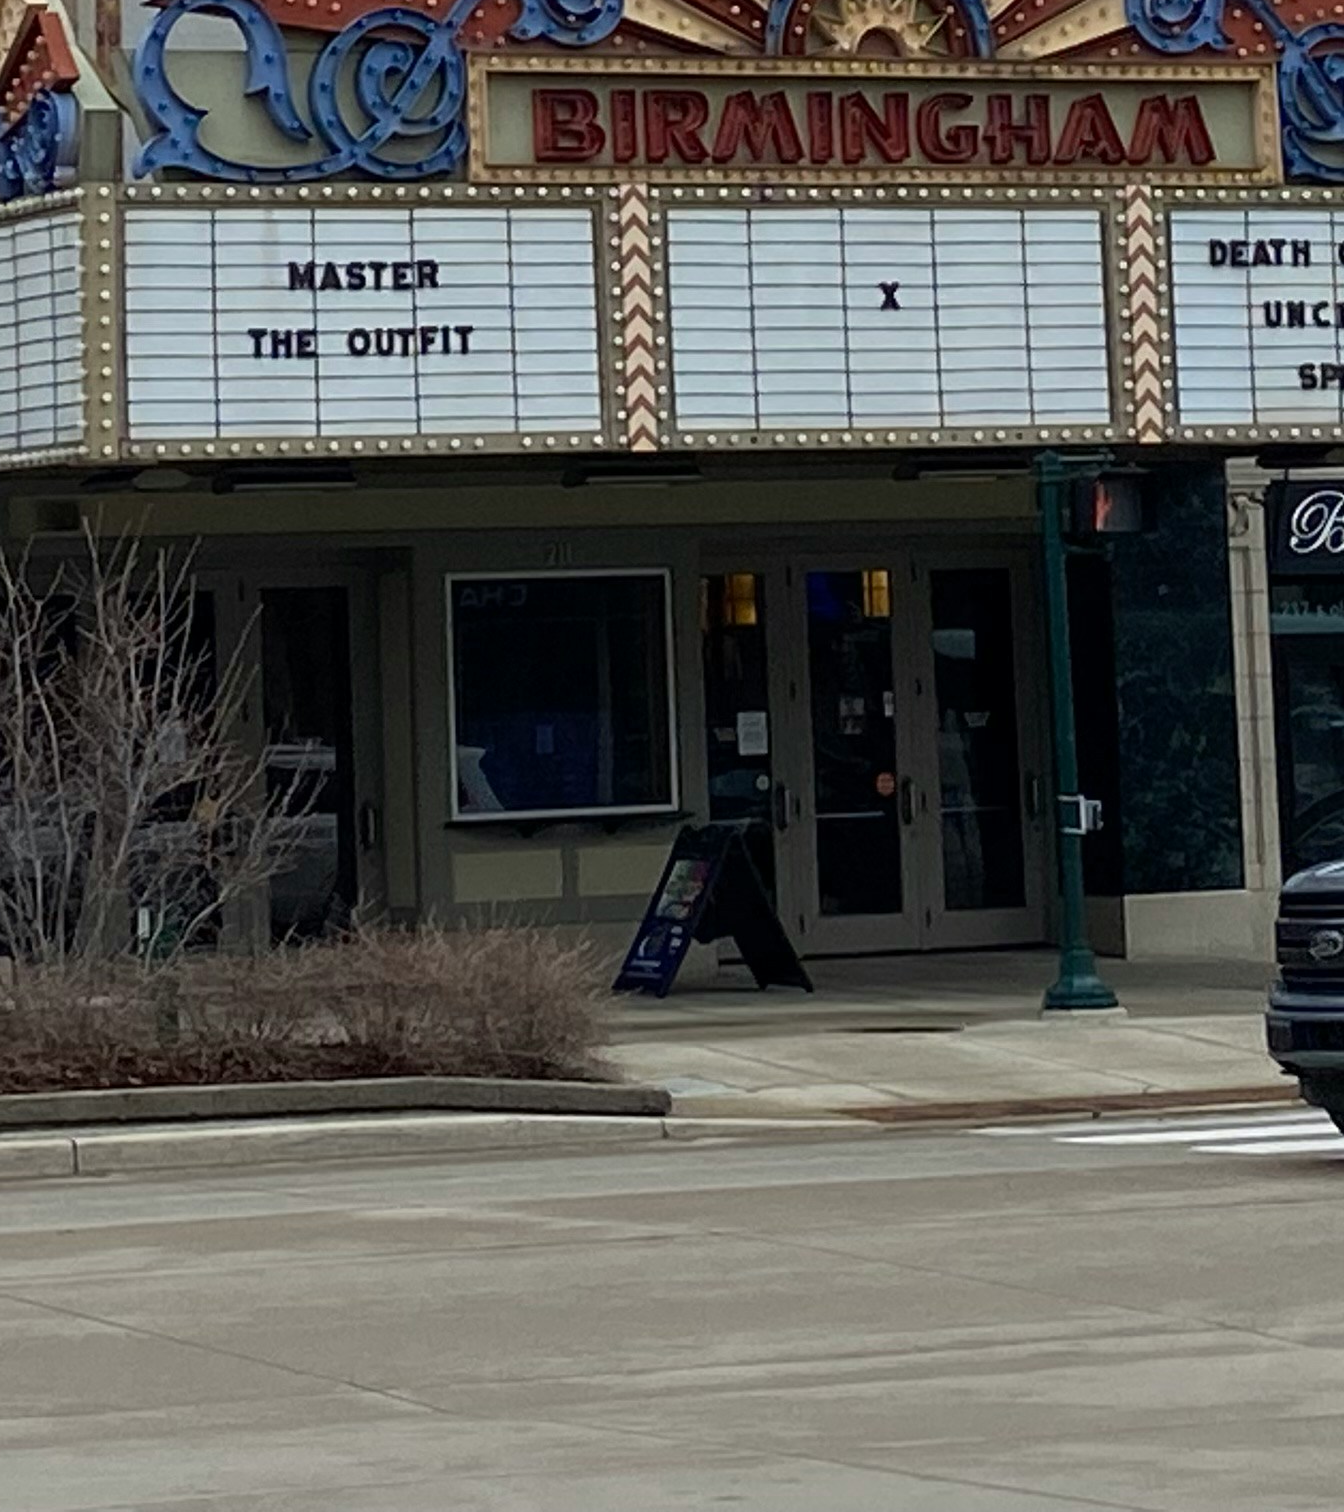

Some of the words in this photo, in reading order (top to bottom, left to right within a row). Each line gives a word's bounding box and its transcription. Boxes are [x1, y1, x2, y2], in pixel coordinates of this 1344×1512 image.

[531, 88, 1217, 164] BIRMINGHAM
[1209, 239, 1310, 267] DEATH
[288, 260, 439, 291] MASTER
[878, 280, 901, 311] X
[248, 328, 318, 359] THE
[347, 325, 473, 357] OUTFIT
